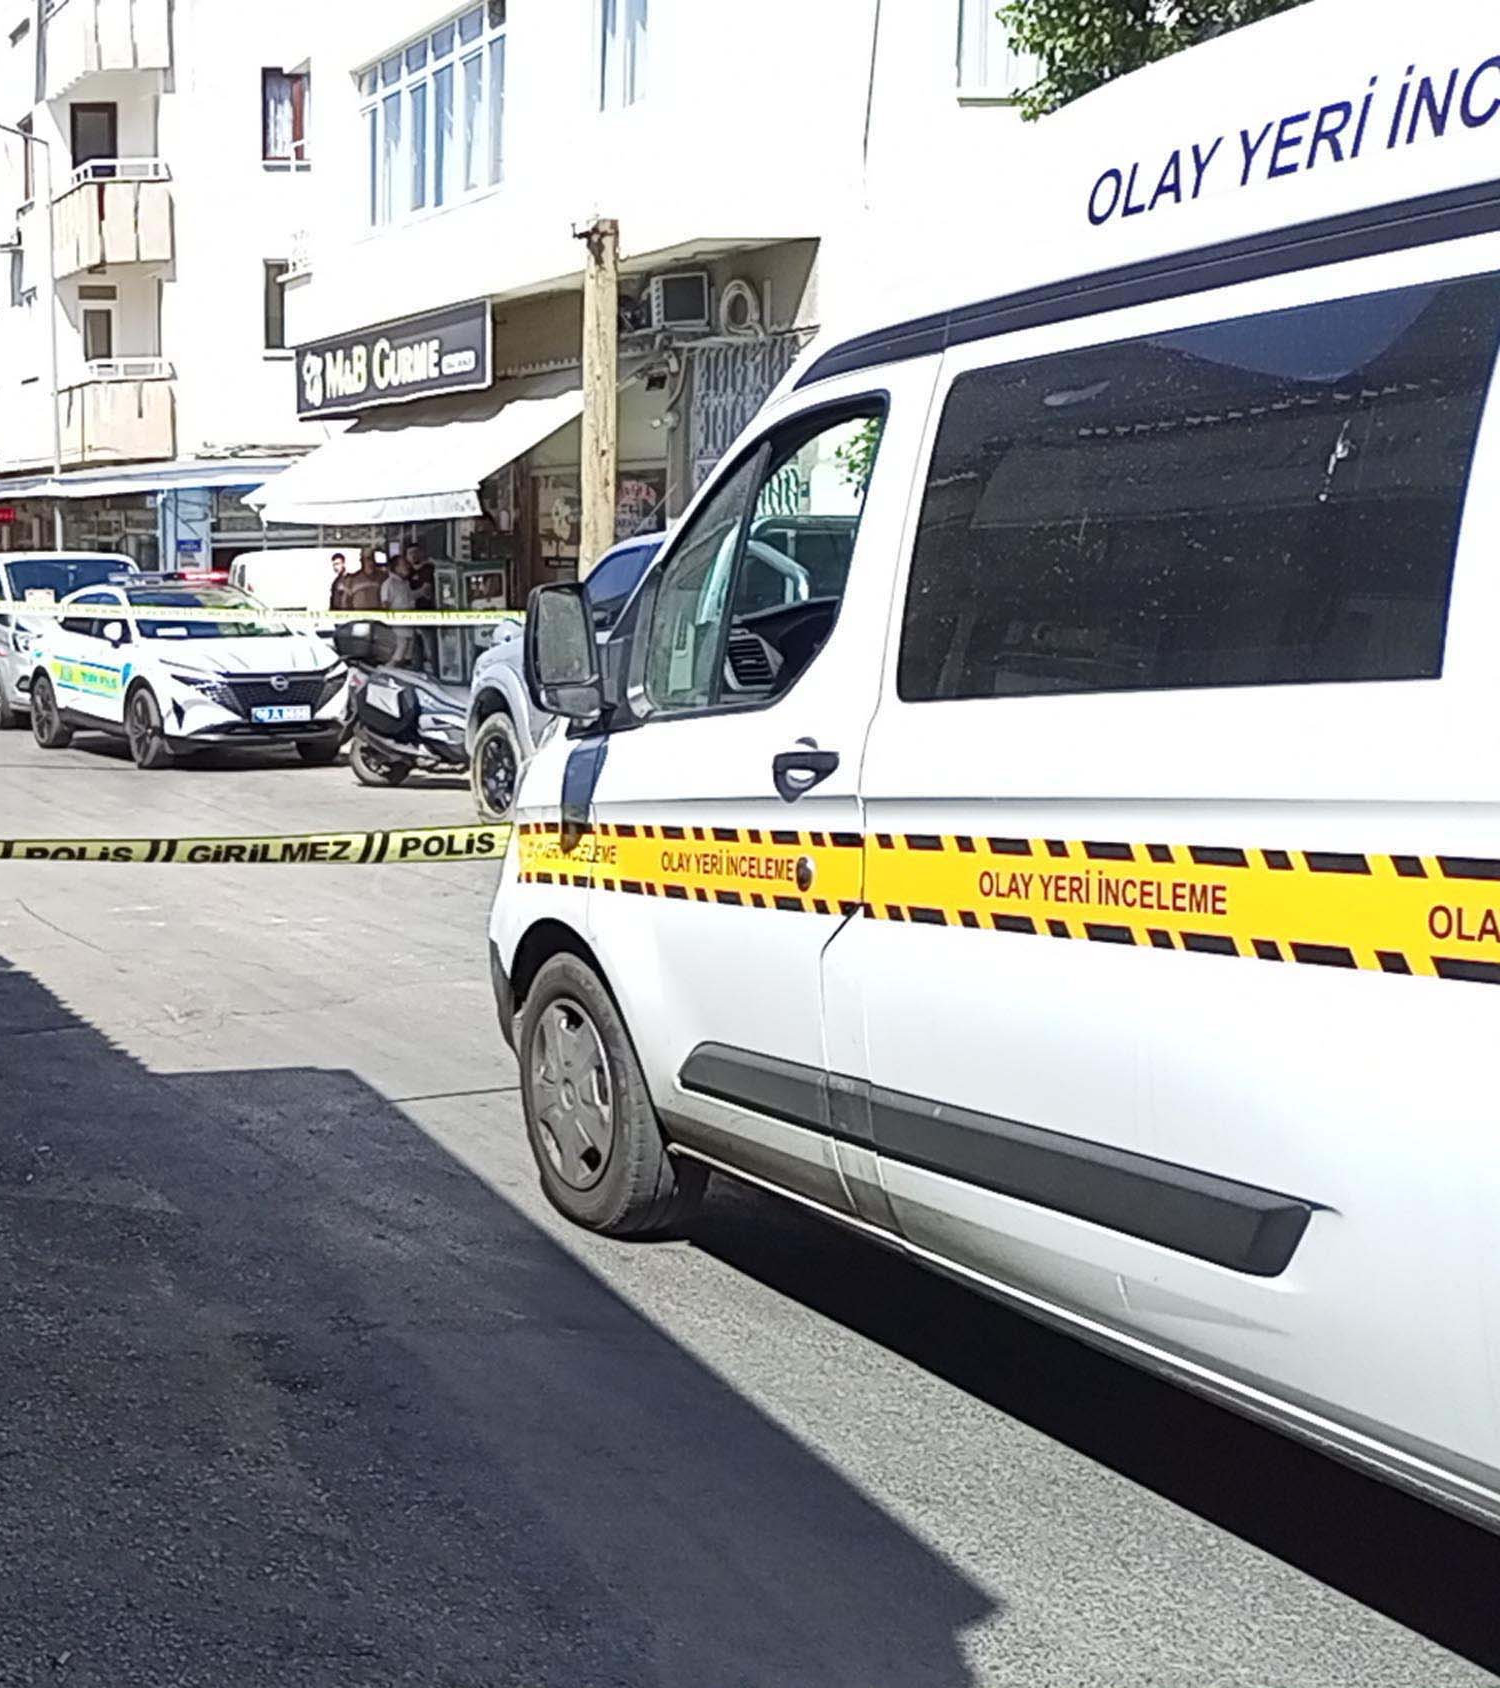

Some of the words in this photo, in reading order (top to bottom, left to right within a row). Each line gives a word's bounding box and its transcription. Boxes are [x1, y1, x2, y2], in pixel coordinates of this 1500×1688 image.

[1087, 135, 1225, 226] OLAY
[1239, 75, 1379, 187] YERİ
[400, 832, 495, 858] POLİS
[662, 850, 692, 872] OLAY
[694, 849, 724, 875] YERİ
[726, 849, 794, 882] İNCELEME
[979, 871, 1035, 899] OLAY
[1041, 869, 1092, 903] YERİ
[1098, 870, 1228, 916] İNCELEME
